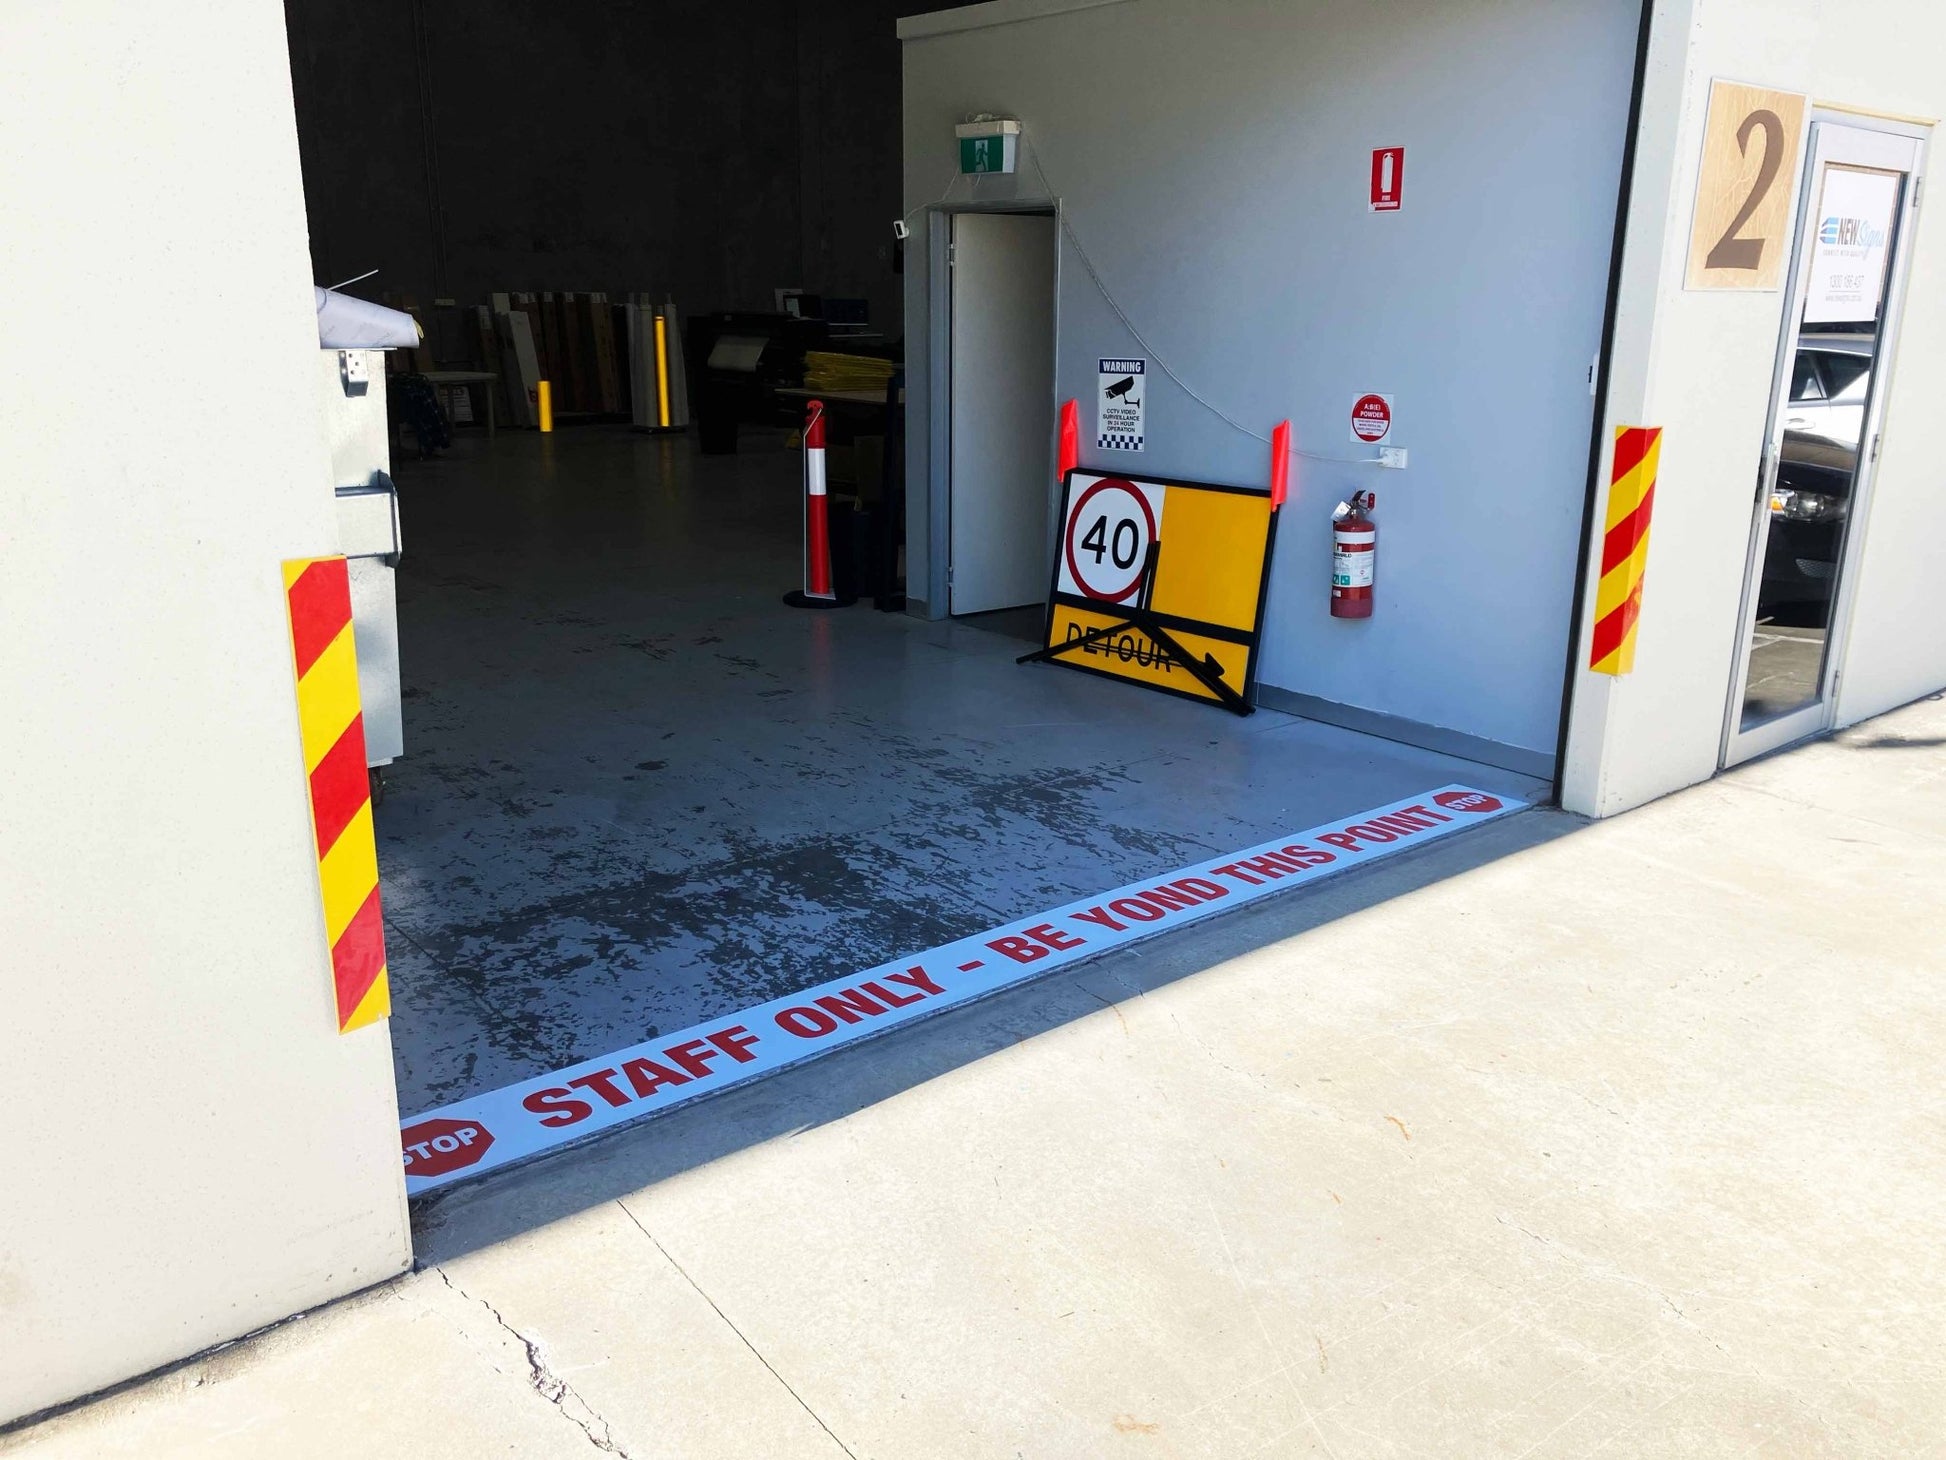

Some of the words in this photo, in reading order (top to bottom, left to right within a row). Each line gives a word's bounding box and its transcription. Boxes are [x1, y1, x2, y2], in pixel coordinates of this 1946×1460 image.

[1705, 109, 1784, 270] 2
[1838, 217, 1860, 245] NEW
[1102, 360, 1142, 373] WARNING
[1360, 410, 1384, 418] POWDER
[1081, 515, 1140, 570] 40
[1066, 622, 1172, 673] DETOUR
[522, 1025, 761, 1128] STAFF
[774, 965, 947, 1039] ONLY
[984, 923, 1088, 964] BE
[1068, 877, 1230, 932] YOND
[1209, 844, 1337, 886] THIS
[1315, 805, 1454, 852] POINT
[1445, 794, 1488, 810] STOP
